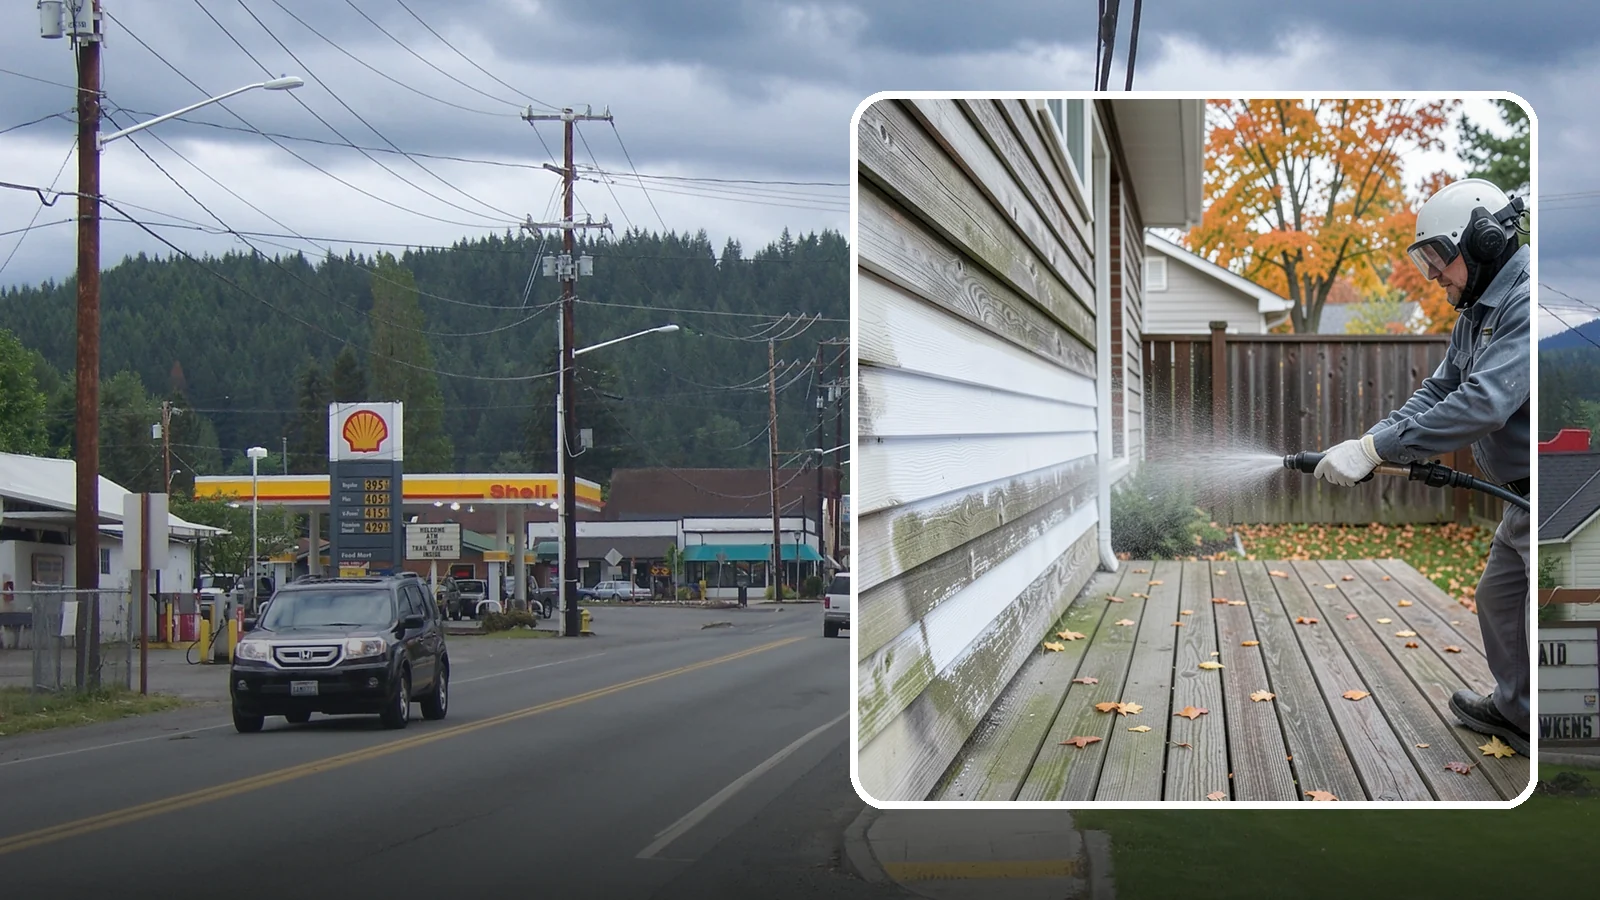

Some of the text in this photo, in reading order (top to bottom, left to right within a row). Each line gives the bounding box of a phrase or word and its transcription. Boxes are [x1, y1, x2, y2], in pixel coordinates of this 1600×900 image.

[366, 480, 383, 490] 395
[490, 484, 547, 499] Shell
[366, 494, 383, 504] 405
[366, 508, 383, 518] 415
[366, 522, 383, 533] 429
[1539, 642, 1567, 666] AID
